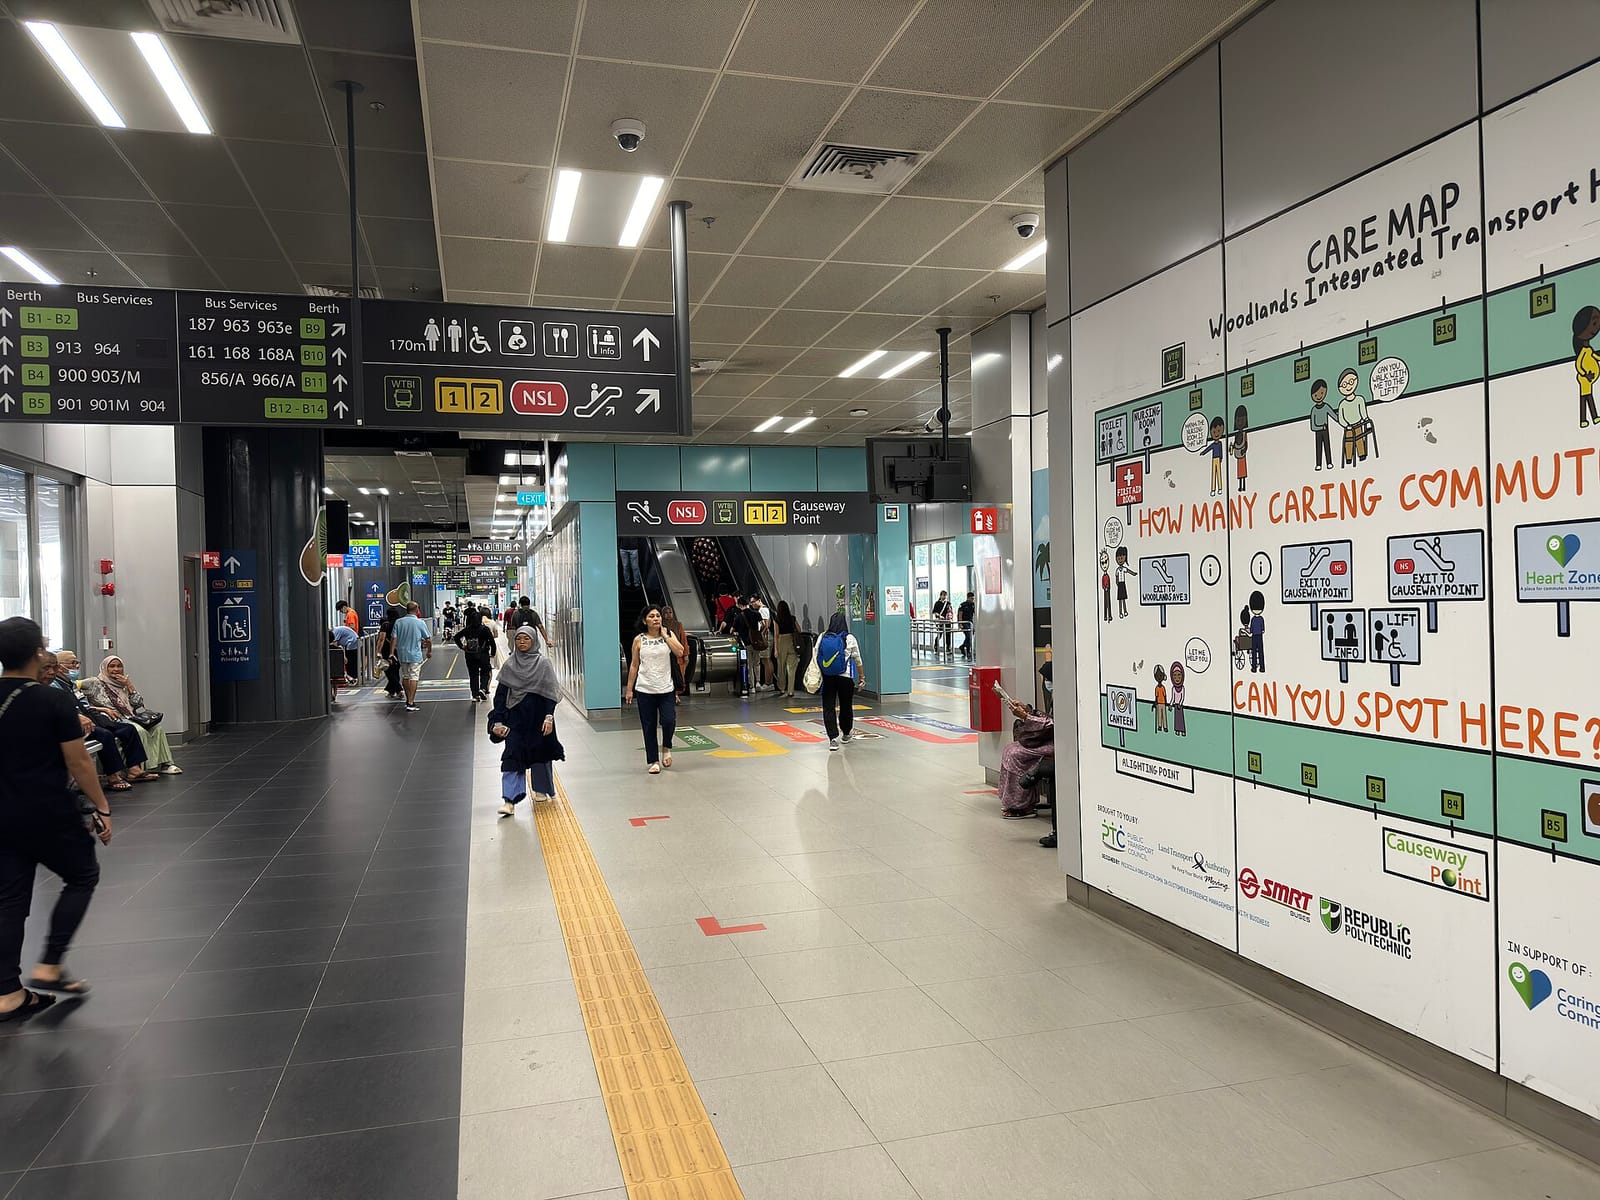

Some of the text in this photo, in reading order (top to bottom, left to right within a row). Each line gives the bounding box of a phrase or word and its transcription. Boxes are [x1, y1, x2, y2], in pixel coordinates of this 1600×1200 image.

[1307, 183, 1460, 274] CARE MAP
[1209, 288, 1298, 339] Woodlands
[1304, 237, 1423, 307] Integrated
[1431, 181, 1579, 259] Transport
[7, 289, 153, 306] Berth Bus Services
[1537, 295, 1549, 307] B9
[205, 298, 340, 314] Bus Services Berth
[27, 313, 71, 325] B1 B2
[188, 318, 320, 334] 187 963 963e B9
[1437, 324, 1453, 335] B10
[27, 341, 121, 355] B3 913 964
[390, 338, 425, 352] 170m
[601, 346, 615, 356] Info
[1361, 345, 1376, 356] B11
[188, 346, 324, 361] 161 168 168A B10
[1296, 363, 1308, 373] B12
[1378, 363, 1400, 374] CAN YOU
[28, 370, 141, 385] B4 900 903/M
[201, 372, 323, 388] 856/A 966/A B11
[1372, 368, 1407, 382] WALK WITH
[391, 380, 415, 389] WTBI
[1374, 381, 1383, 390] ME
[1392, 377, 1405, 386] THE
[29, 398, 166, 412] B5 901 901M 904
[449, 392, 490, 407] 1 2
[523, 390, 557, 407] NSL
[270, 403, 324, 415] B12 B14
[1134, 406, 1160, 421] NURSING
[1102, 418, 1123, 432] TOILET
[1139, 418, 1155, 430] ROOM
[1117, 486, 1141, 496] FIRST AID
[1192, 492, 1258, 533] MANY
[1269, 477, 1382, 525] CARING
[1399, 448, 1600, 511] COMMUT
[1123, 495, 1136, 503] ROOM
[676, 506, 698, 518] NSL
[793, 500, 846, 513] Causeway
[753, 510, 778, 519] 1 2
[793, 514, 820, 524] Point
[1300, 578, 1330, 588] EXIT TO
[1413, 573, 1455, 584] EXIT TO
[1526, 571, 1565, 585] Heart
[1153, 585, 1166, 593] EXIT
[1285, 588, 1348, 598] CAUSEWAY POINT
[1392, 584, 1479, 596] CAUSEWAY POINT
[1387, 614, 1416, 626] LIFT
[1335, 648, 1359, 659] INFO
[1233, 680, 1277, 717] CAN
[1110, 713, 1134, 727] CANTEEN
[1251, 757, 1258, 767] B1
[1122, 758, 1180, 780] ALIGHTING POINT
[1304, 771, 1313, 781] B2
[1371, 783, 1381, 793] B3
[1447, 799, 1459, 810] B4
[1097, 804, 1116, 817] BROUGHT
[1116, 810, 1122, 819] TO
[1547, 819, 1560, 832] B5
[1102, 819, 1125, 849] PTC
[1127, 832, 1144, 844] PUBLIC
[1127, 840, 1154, 855] TRANSPORT
[1387, 833, 1467, 871] Causeway
[1127, 848, 1148, 861] COUNCIL
[1158, 843, 1231, 877] Land Transport Authority
[1261, 879, 1313, 911] SMRT
[1290, 911, 1311, 923] BUSES
[1344, 924, 1412, 960] POLYTECHNIC
[1507, 940, 1520, 954] IN
[1523, 945, 1568, 971] SUPPORT
[1557, 988, 1600, 1019] Caring
